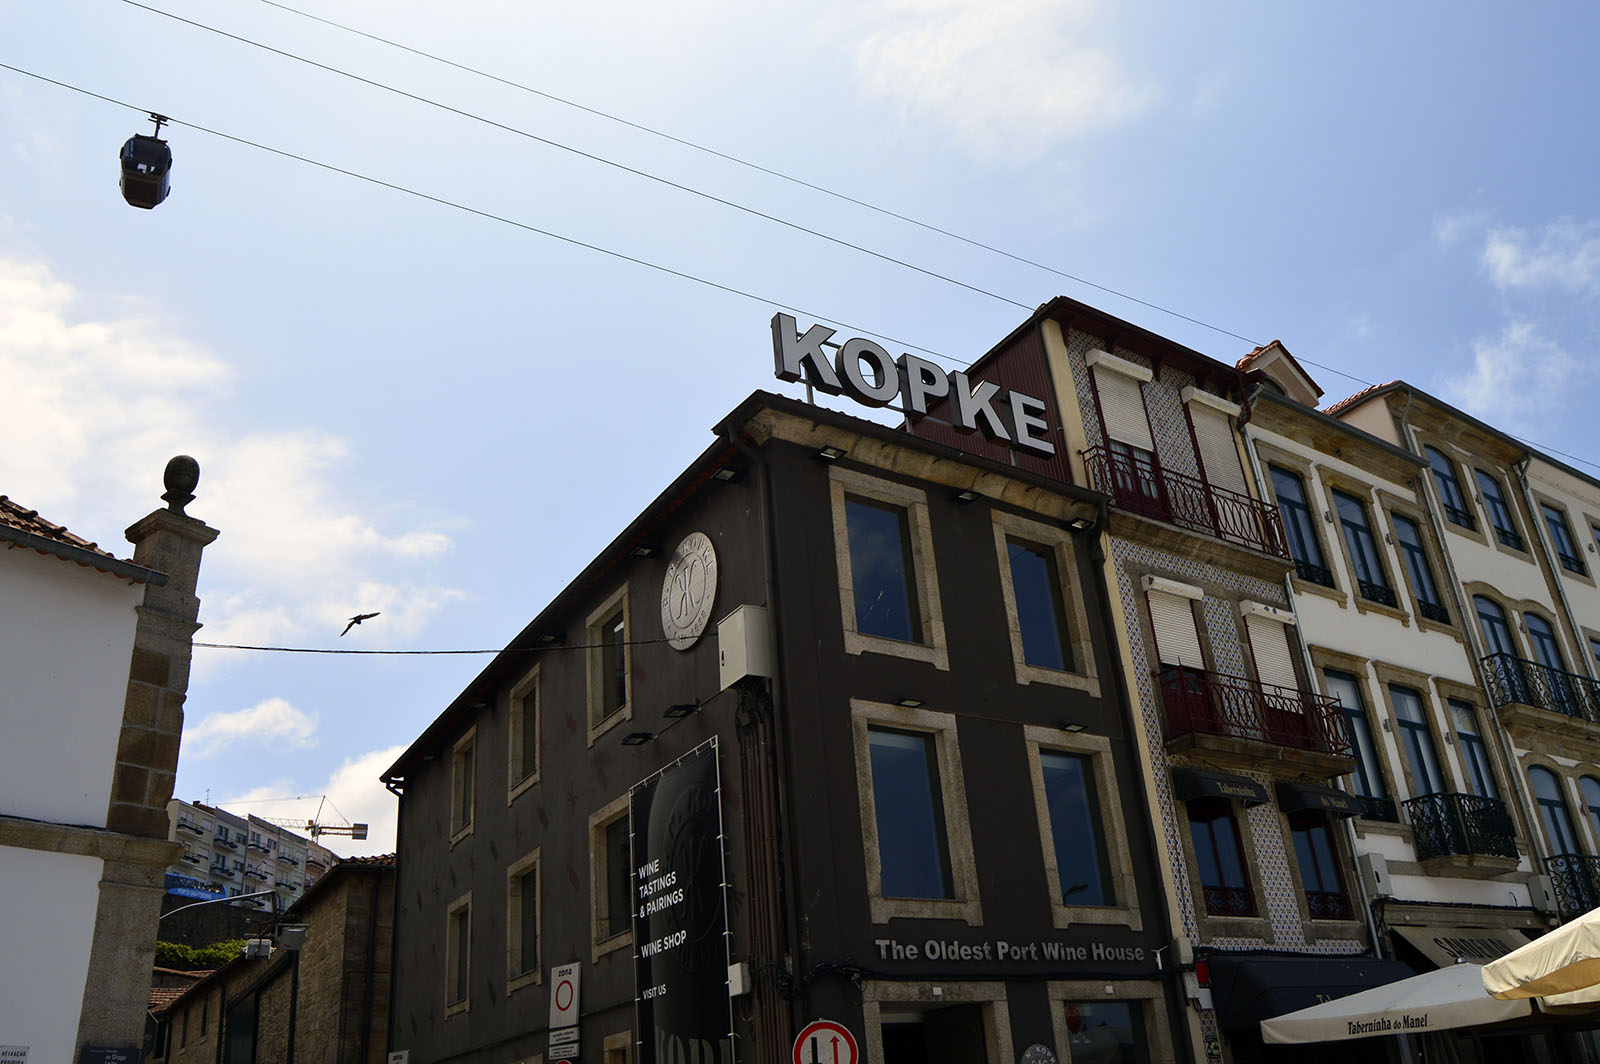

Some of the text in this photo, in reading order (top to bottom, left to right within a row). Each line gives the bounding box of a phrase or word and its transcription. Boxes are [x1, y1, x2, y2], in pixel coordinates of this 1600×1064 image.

[771, 312, 1056, 455] KOPKE
[682, 537, 714, 576] KOPKE
[638, 859, 660, 880] WINE
[639, 871, 677, 899] TASTINGS
[639, 888, 684, 919] & PAIRINGS
[641, 930, 687, 959] WINE SHOP
[875, 939, 1145, 961] The Oldest Port Wine House
[642, 984, 667, 1001] VISIT US
[1347, 1014, 1428, 1035] Taberninha do Manel
